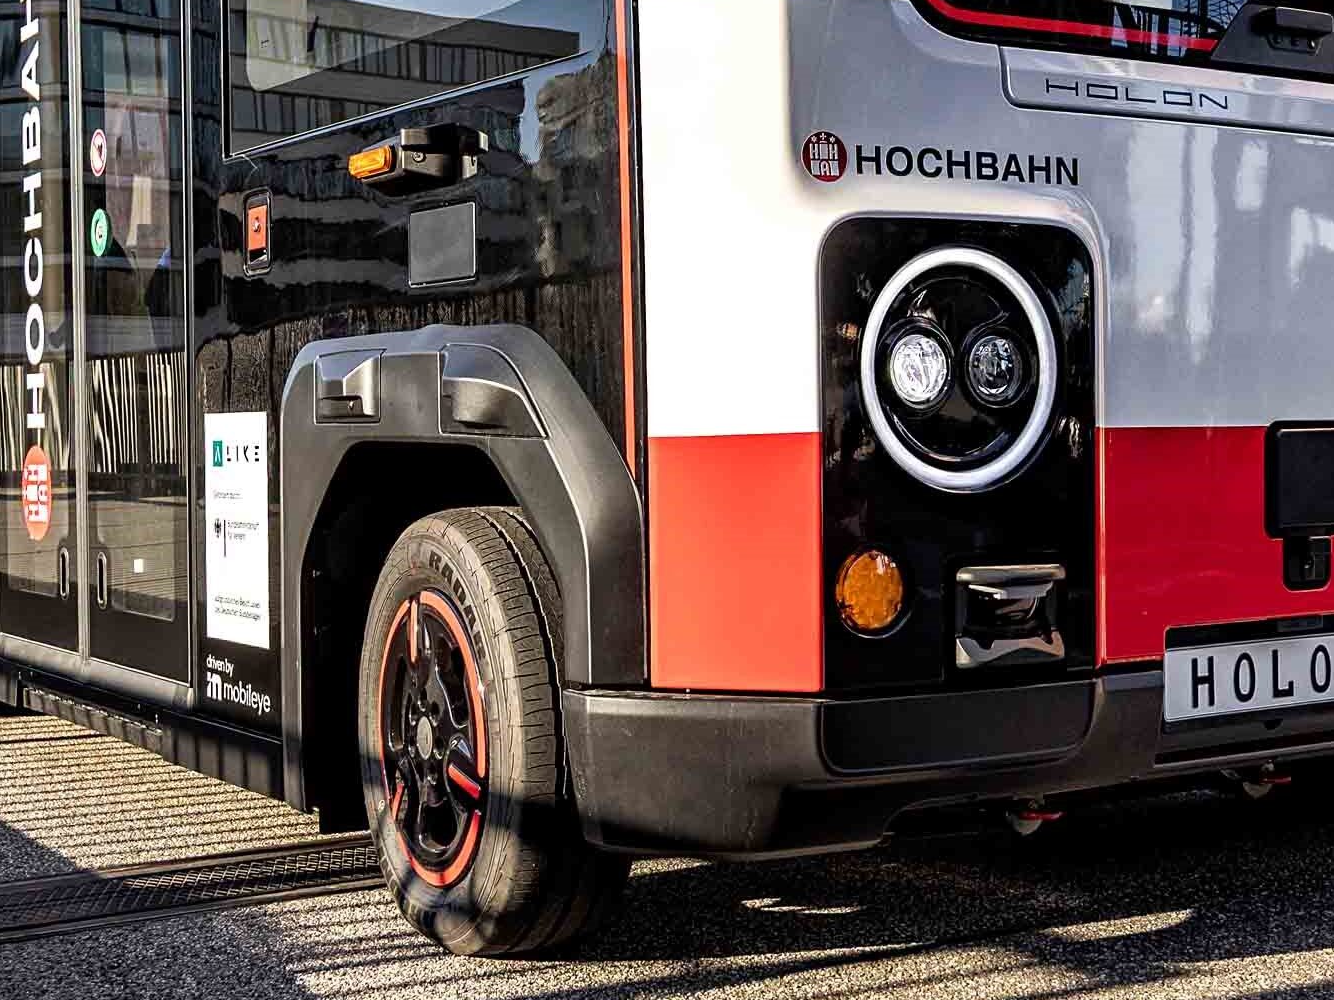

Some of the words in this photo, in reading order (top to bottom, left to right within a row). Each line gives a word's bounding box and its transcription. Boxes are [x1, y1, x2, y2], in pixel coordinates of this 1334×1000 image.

[1045, 78, 1229, 110] HOLON
[855, 144, 1080, 186] HOCHBAHN
[428, 550, 487, 661] RADAR
[206, 653, 225, 672] driven
[225, 658, 234, 677] by
[223, 680, 271, 716] mobileye
